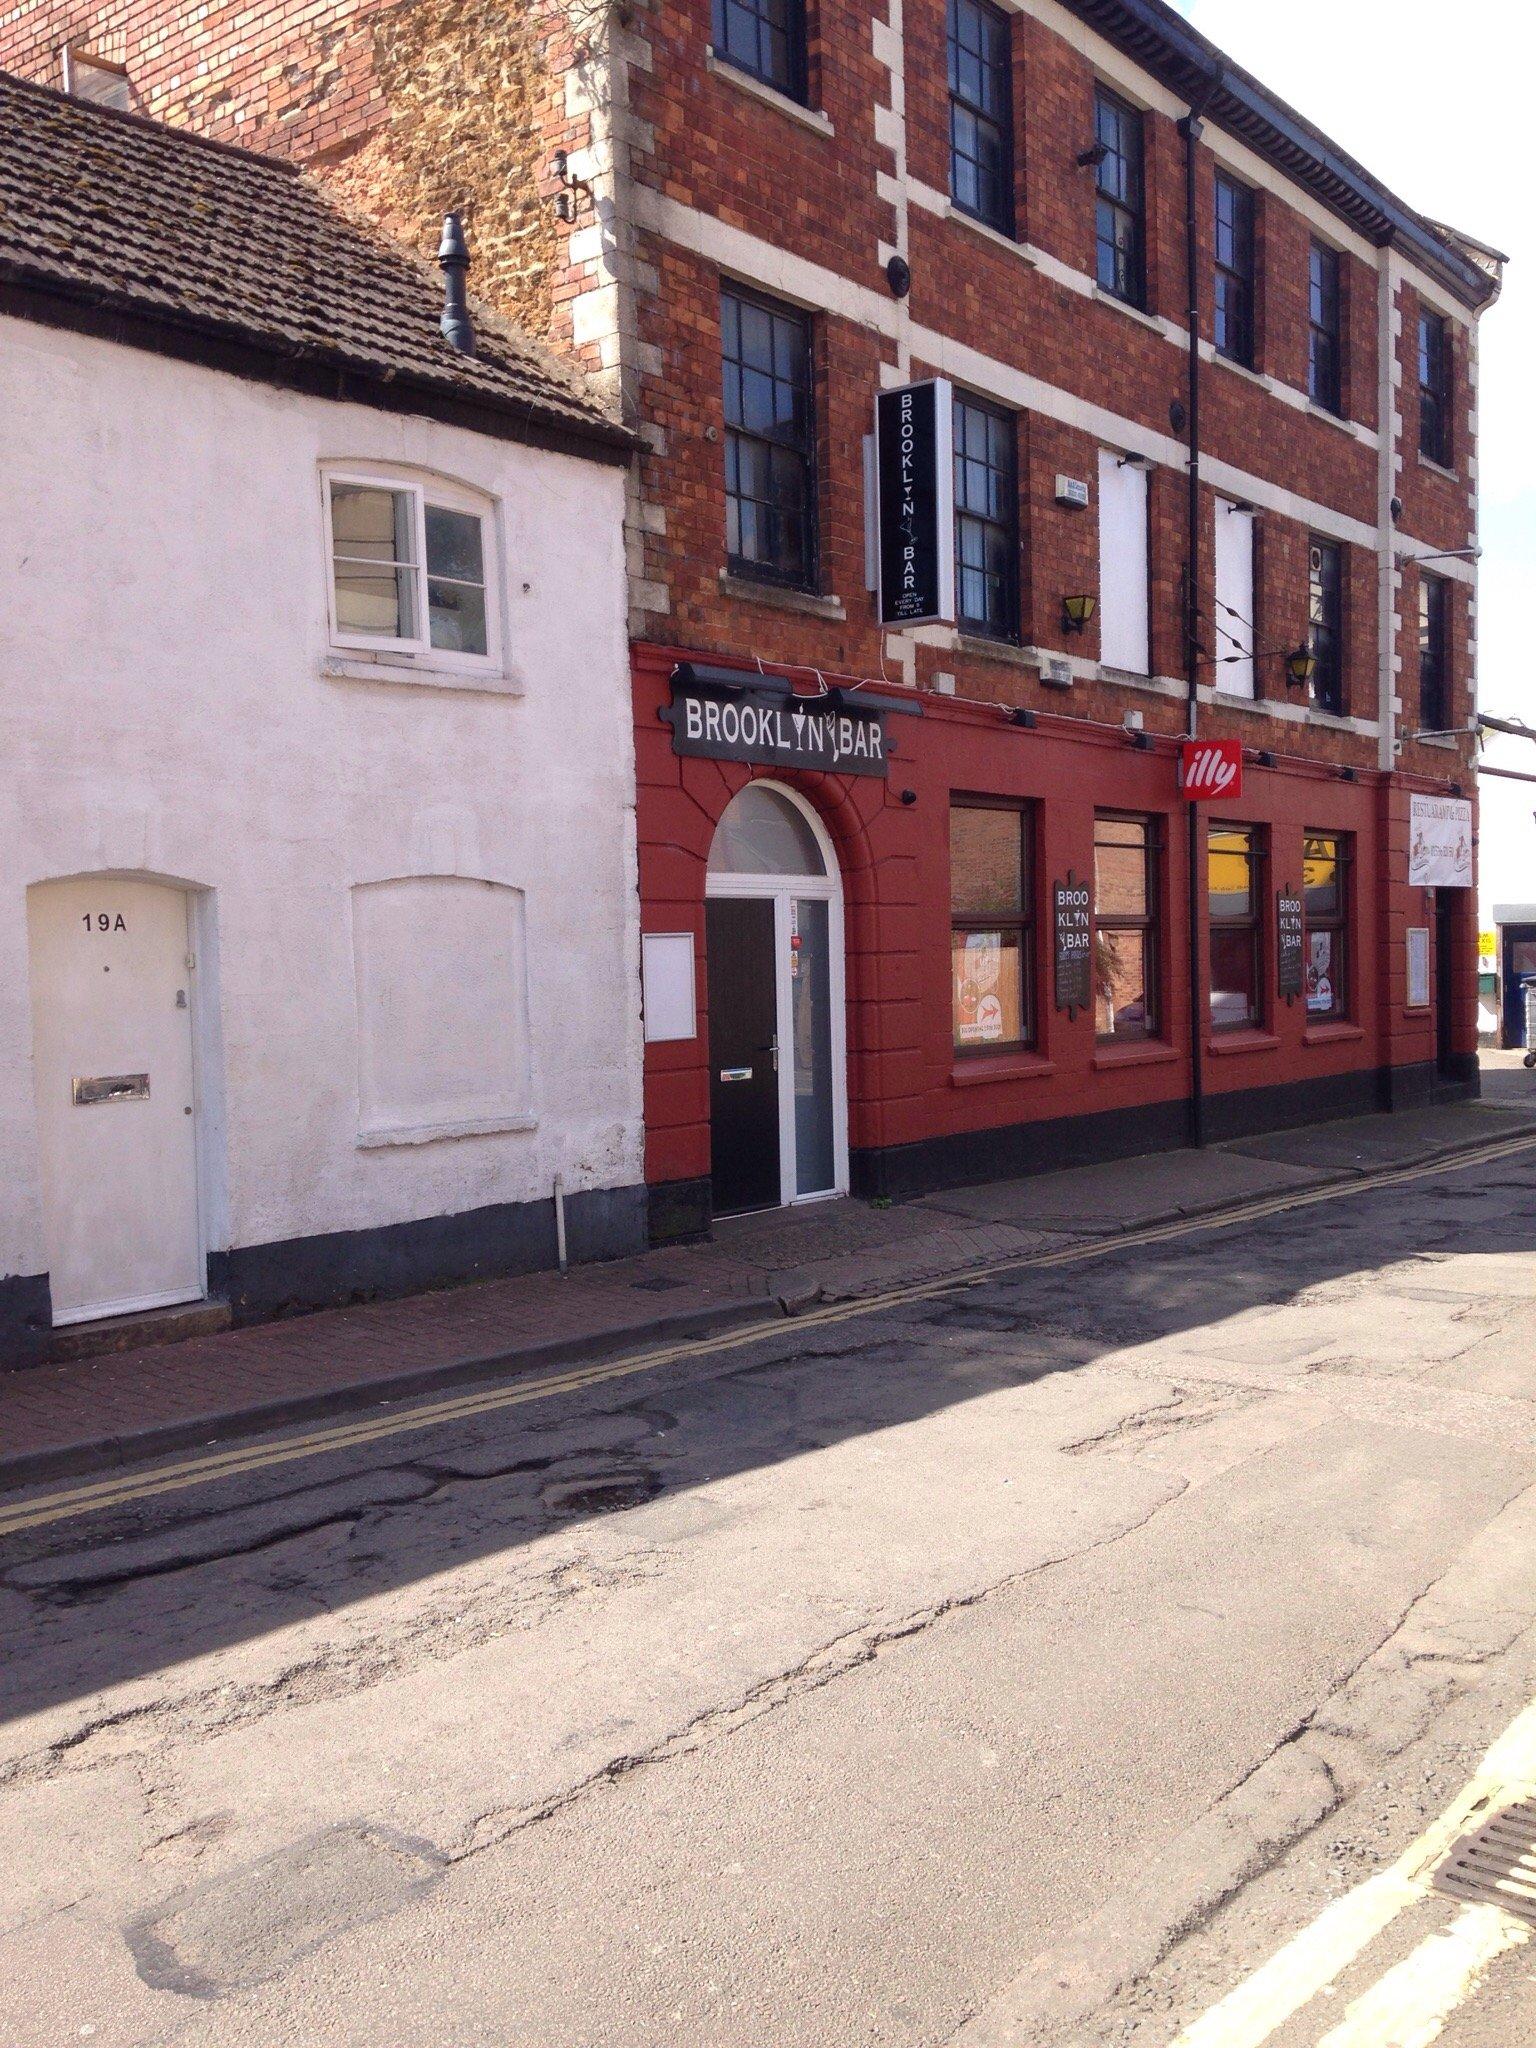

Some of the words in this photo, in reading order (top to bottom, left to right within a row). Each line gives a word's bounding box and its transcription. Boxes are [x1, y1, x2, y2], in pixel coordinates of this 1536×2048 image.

[901, 394, 914, 516] BROOKLYN
[904, 547, 915, 588] BAR
[685, 697, 824, 752] BROOKLYN
[839, 717, 883, 759] BAR
[1186, 749, 1237, 795] illy
[1057, 891, 1089, 906] BROO
[1280, 900, 1301, 912] BROO
[82, 913, 127, 931] 19A
[1058, 910, 1089, 927] KLYN
[1280, 916, 1301, 929] KLYN
[1067, 933, 1090, 948] BAR
[1286, 935, 1302, 947] BAR
